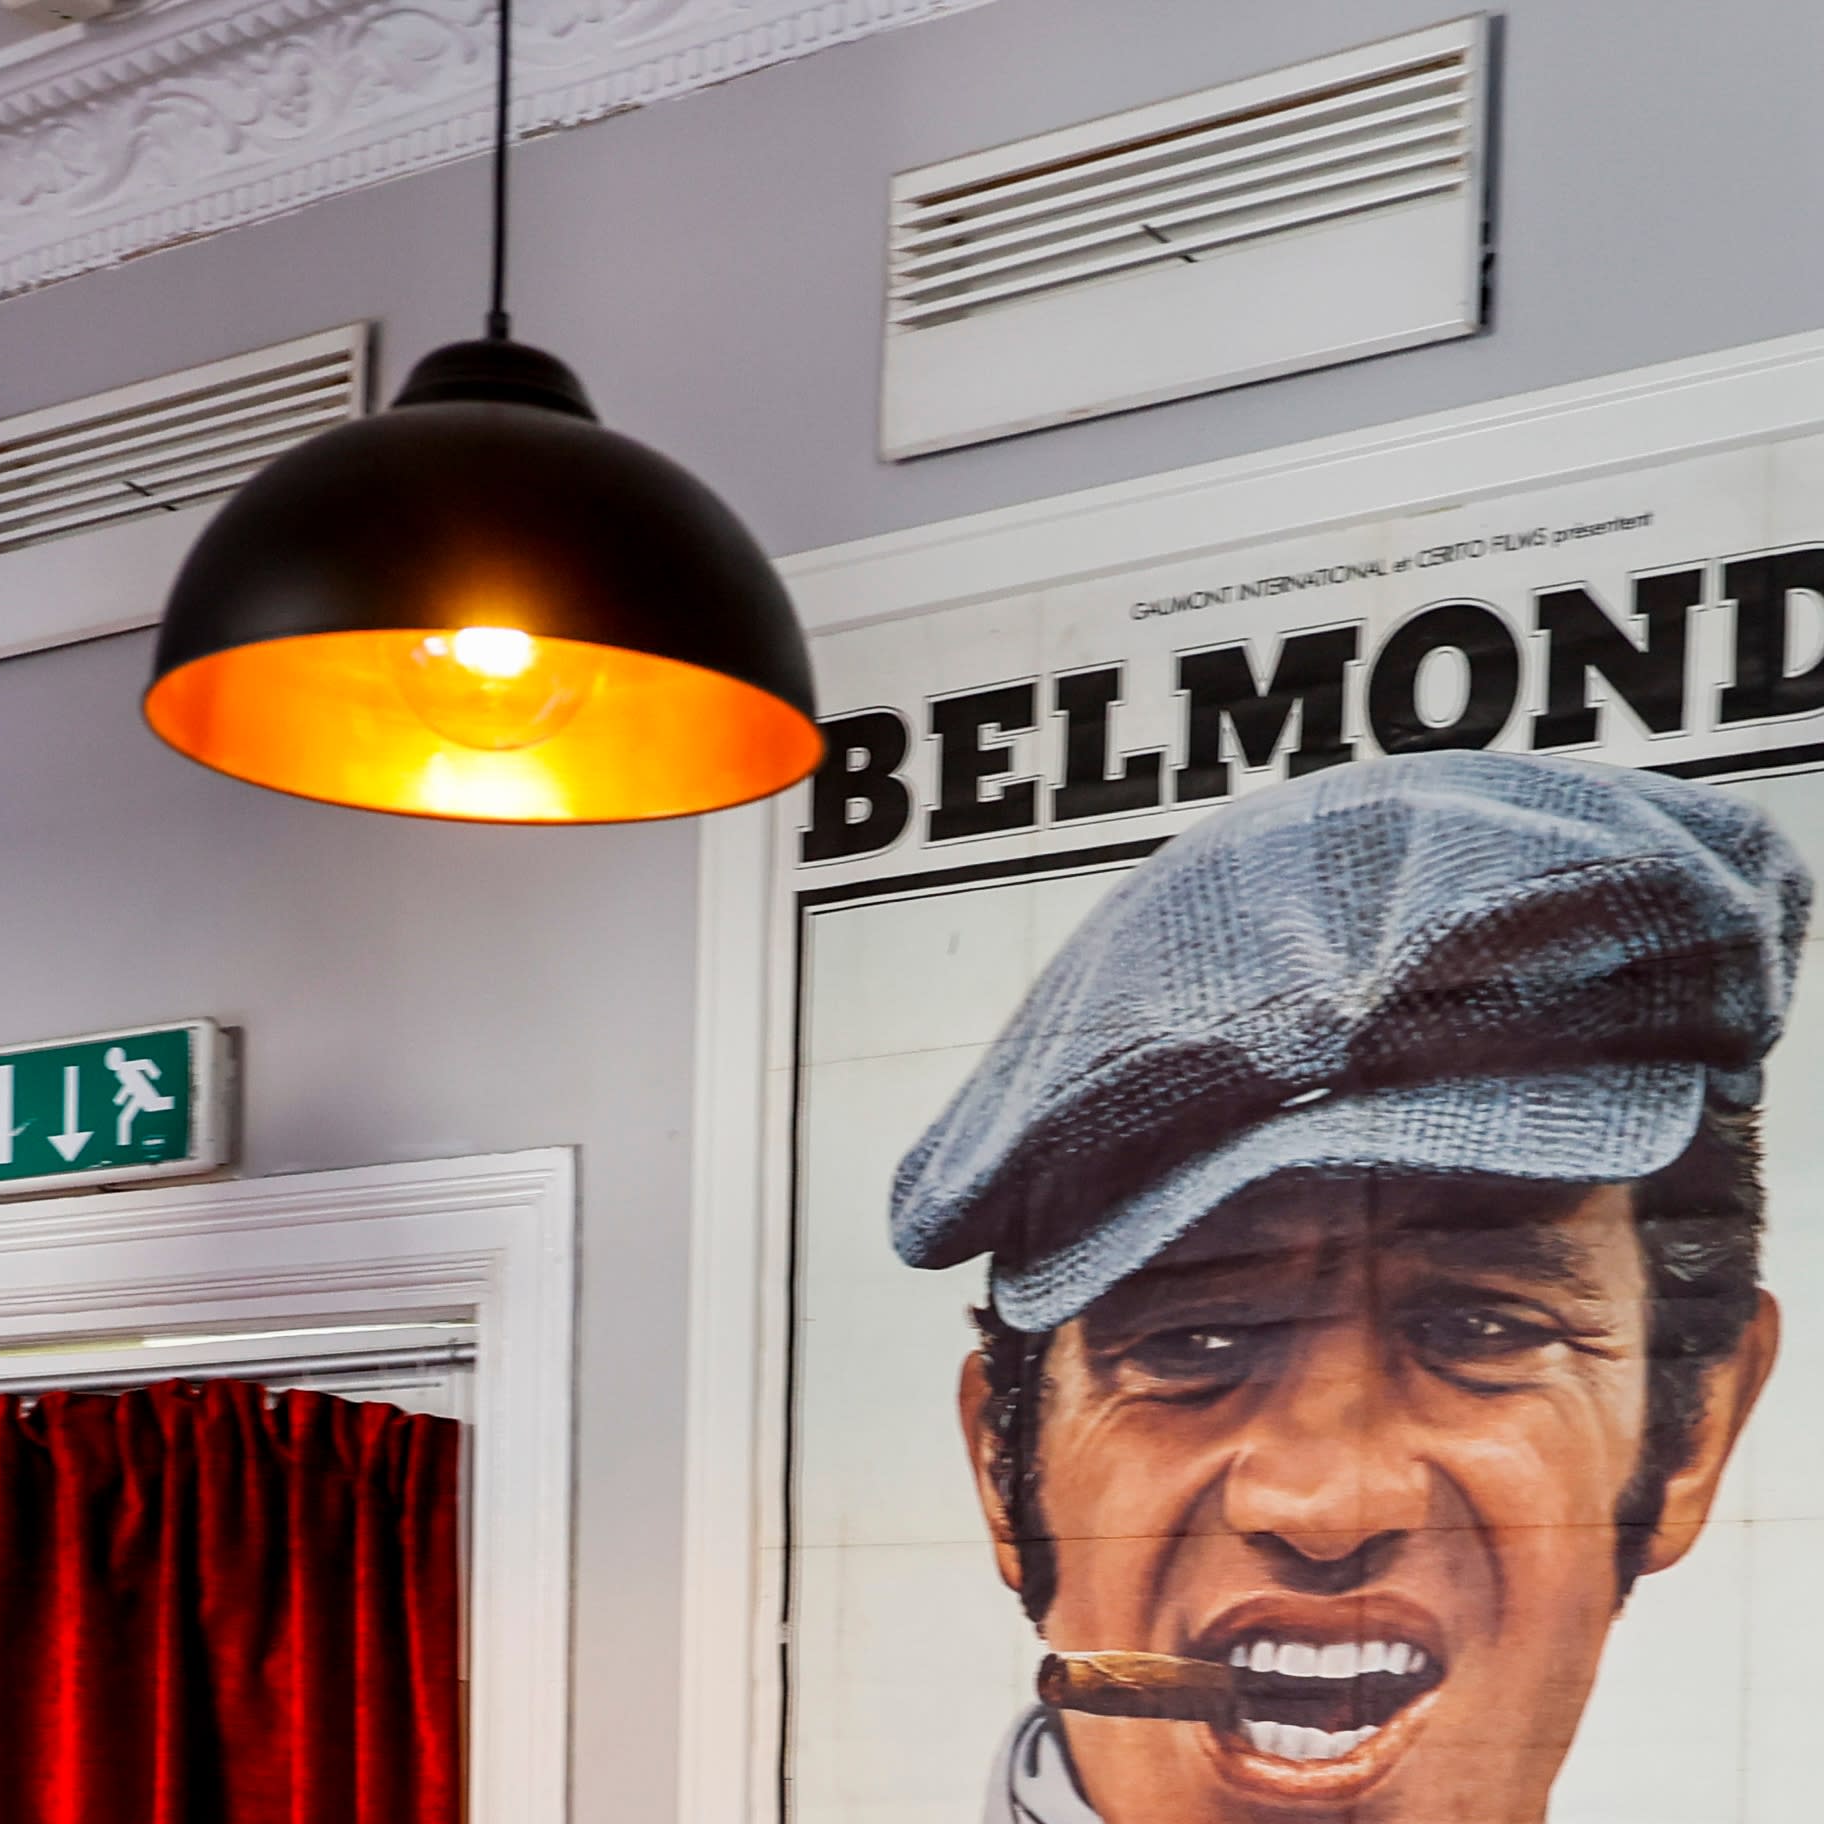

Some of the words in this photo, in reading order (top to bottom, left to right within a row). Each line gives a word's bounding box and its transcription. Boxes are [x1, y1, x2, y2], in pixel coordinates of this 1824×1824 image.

[1130, 586, 1234, 619] GAUMONT
[1239, 557, 1388, 600] INTERNATIONAL
[1491, 526, 1548, 551] FILMS
